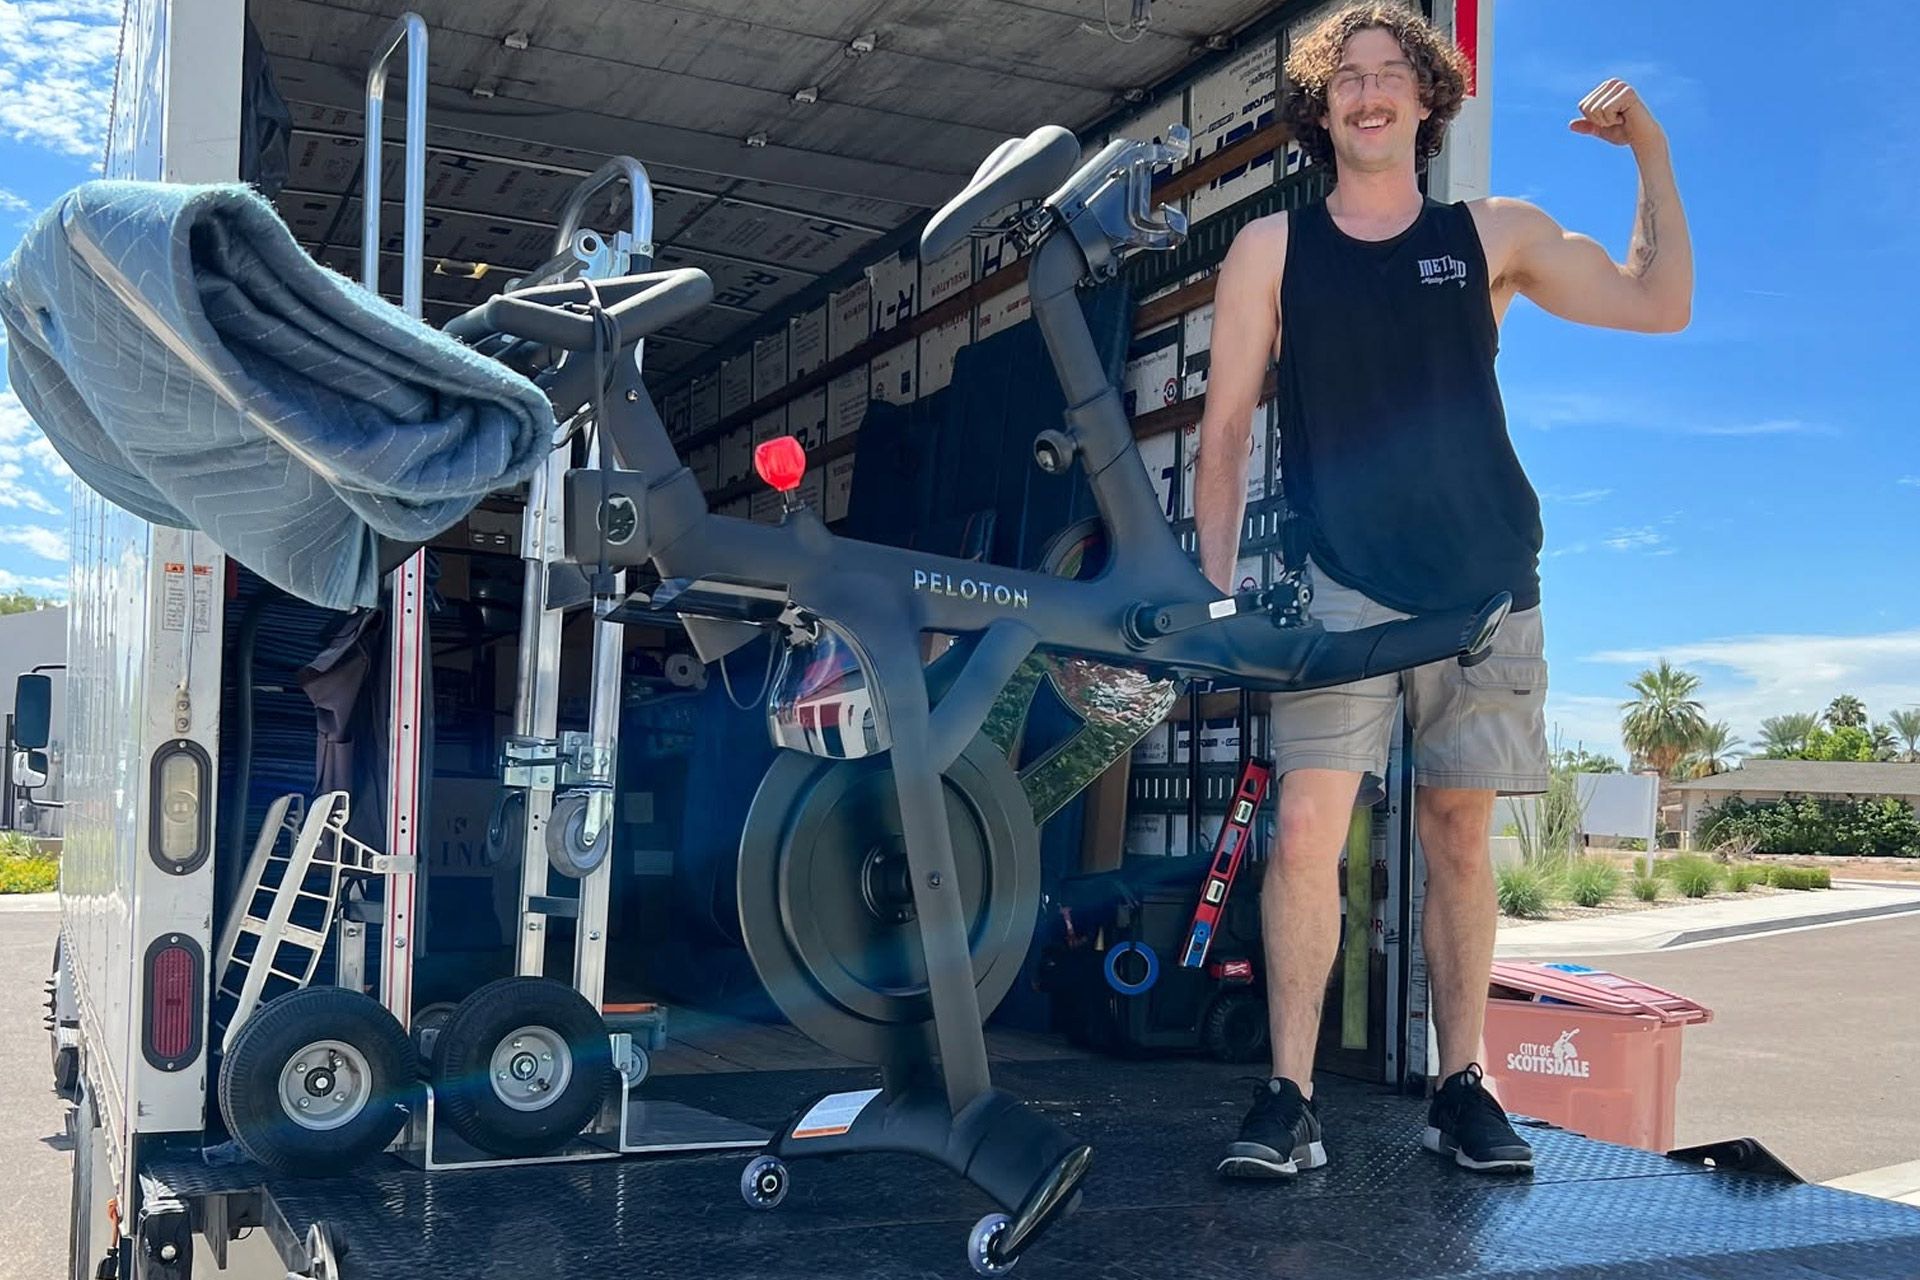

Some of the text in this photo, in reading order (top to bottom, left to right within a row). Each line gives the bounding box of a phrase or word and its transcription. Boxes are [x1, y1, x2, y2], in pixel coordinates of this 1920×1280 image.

[913, 569, 1029, 609] PELOTON
[1519, 1042, 1552, 1057] CITY OF
[1506, 1052, 1590, 1078] SCOTTSDALE
